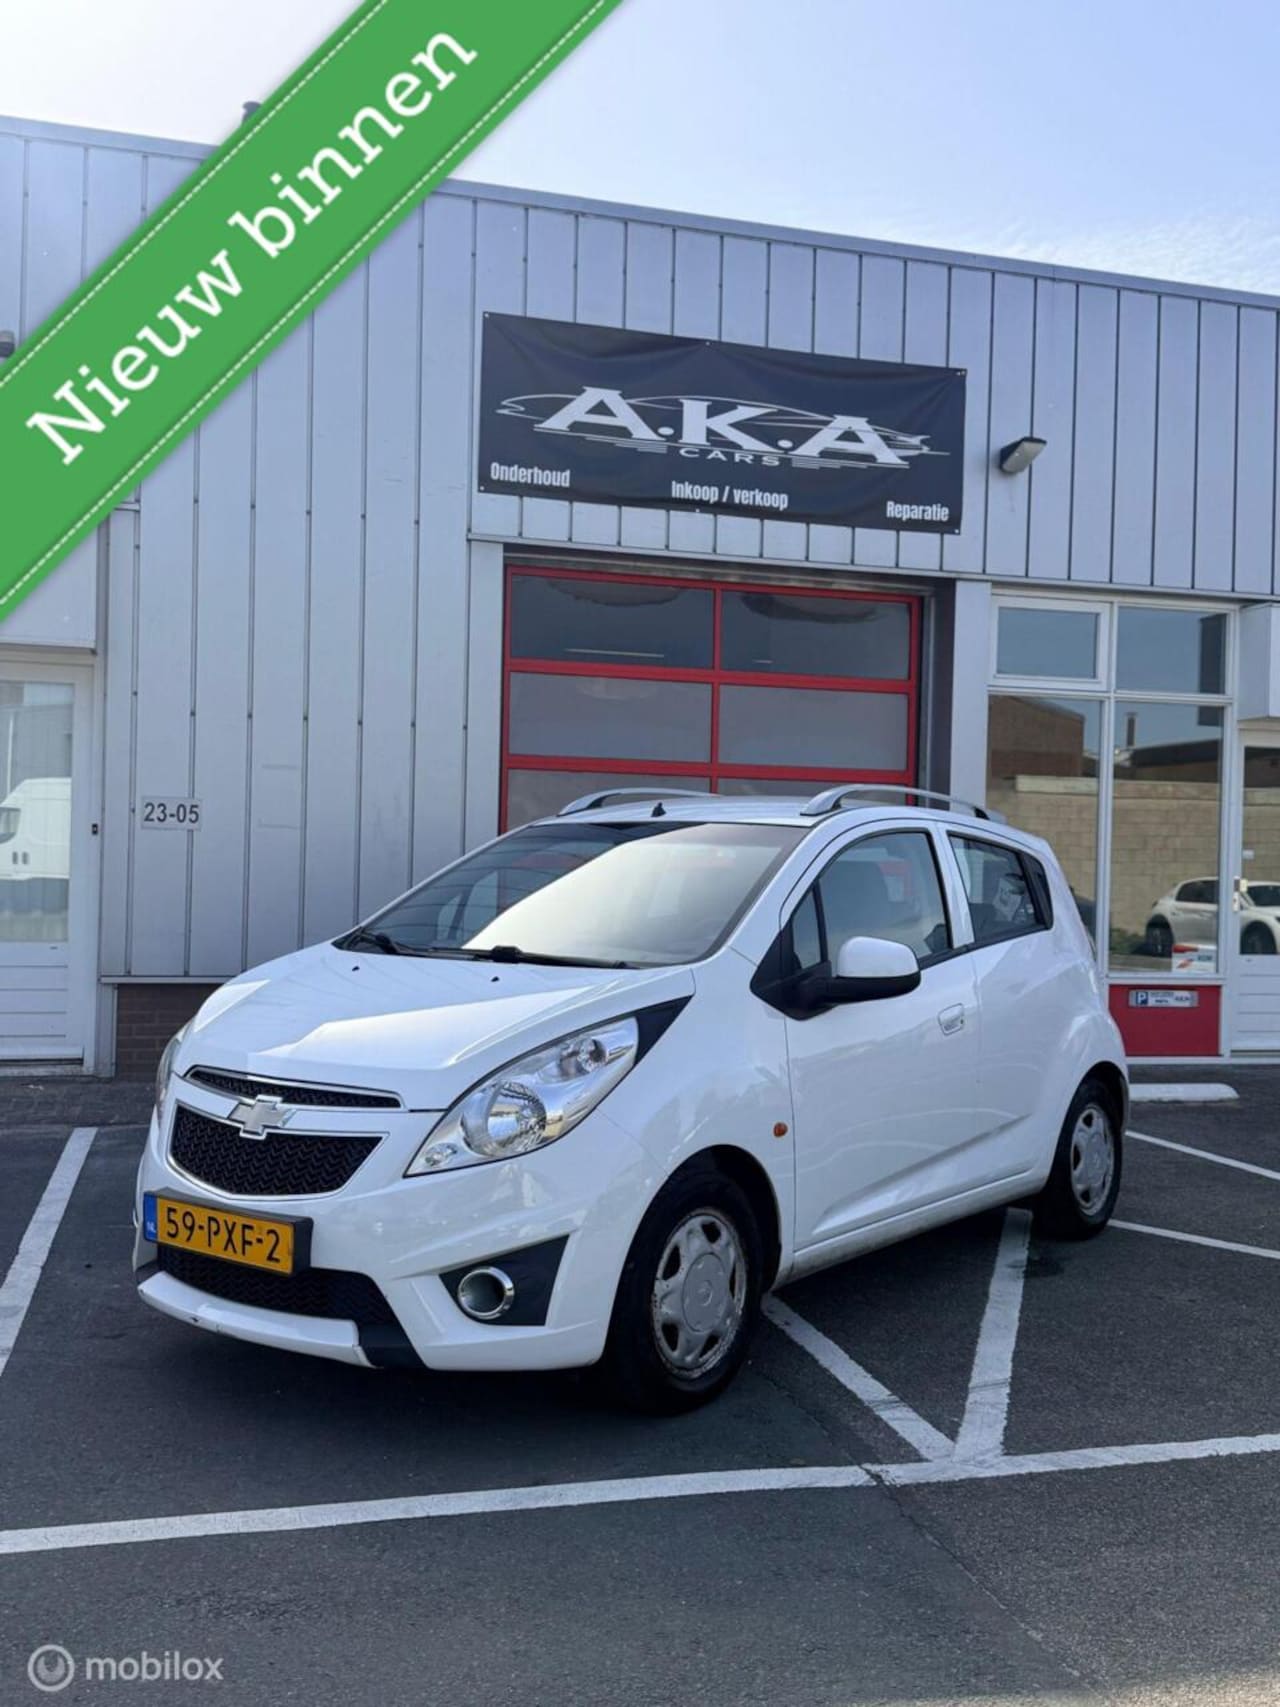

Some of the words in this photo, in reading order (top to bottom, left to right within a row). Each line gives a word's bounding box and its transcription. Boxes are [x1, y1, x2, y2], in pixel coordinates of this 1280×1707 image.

[679, 447, 780, 466] CARS
[490, 461, 571, 488] Onderhoud
[671, 480, 720, 504] Inkoop
[733, 488, 789, 511] verkoop
[886, 500, 949, 522] Reparatie
[143, 802, 200, 824] 23-05
[1137, 992, 1147, 1004] P
[166, 1206, 281, 1264] 59-PXF-2
